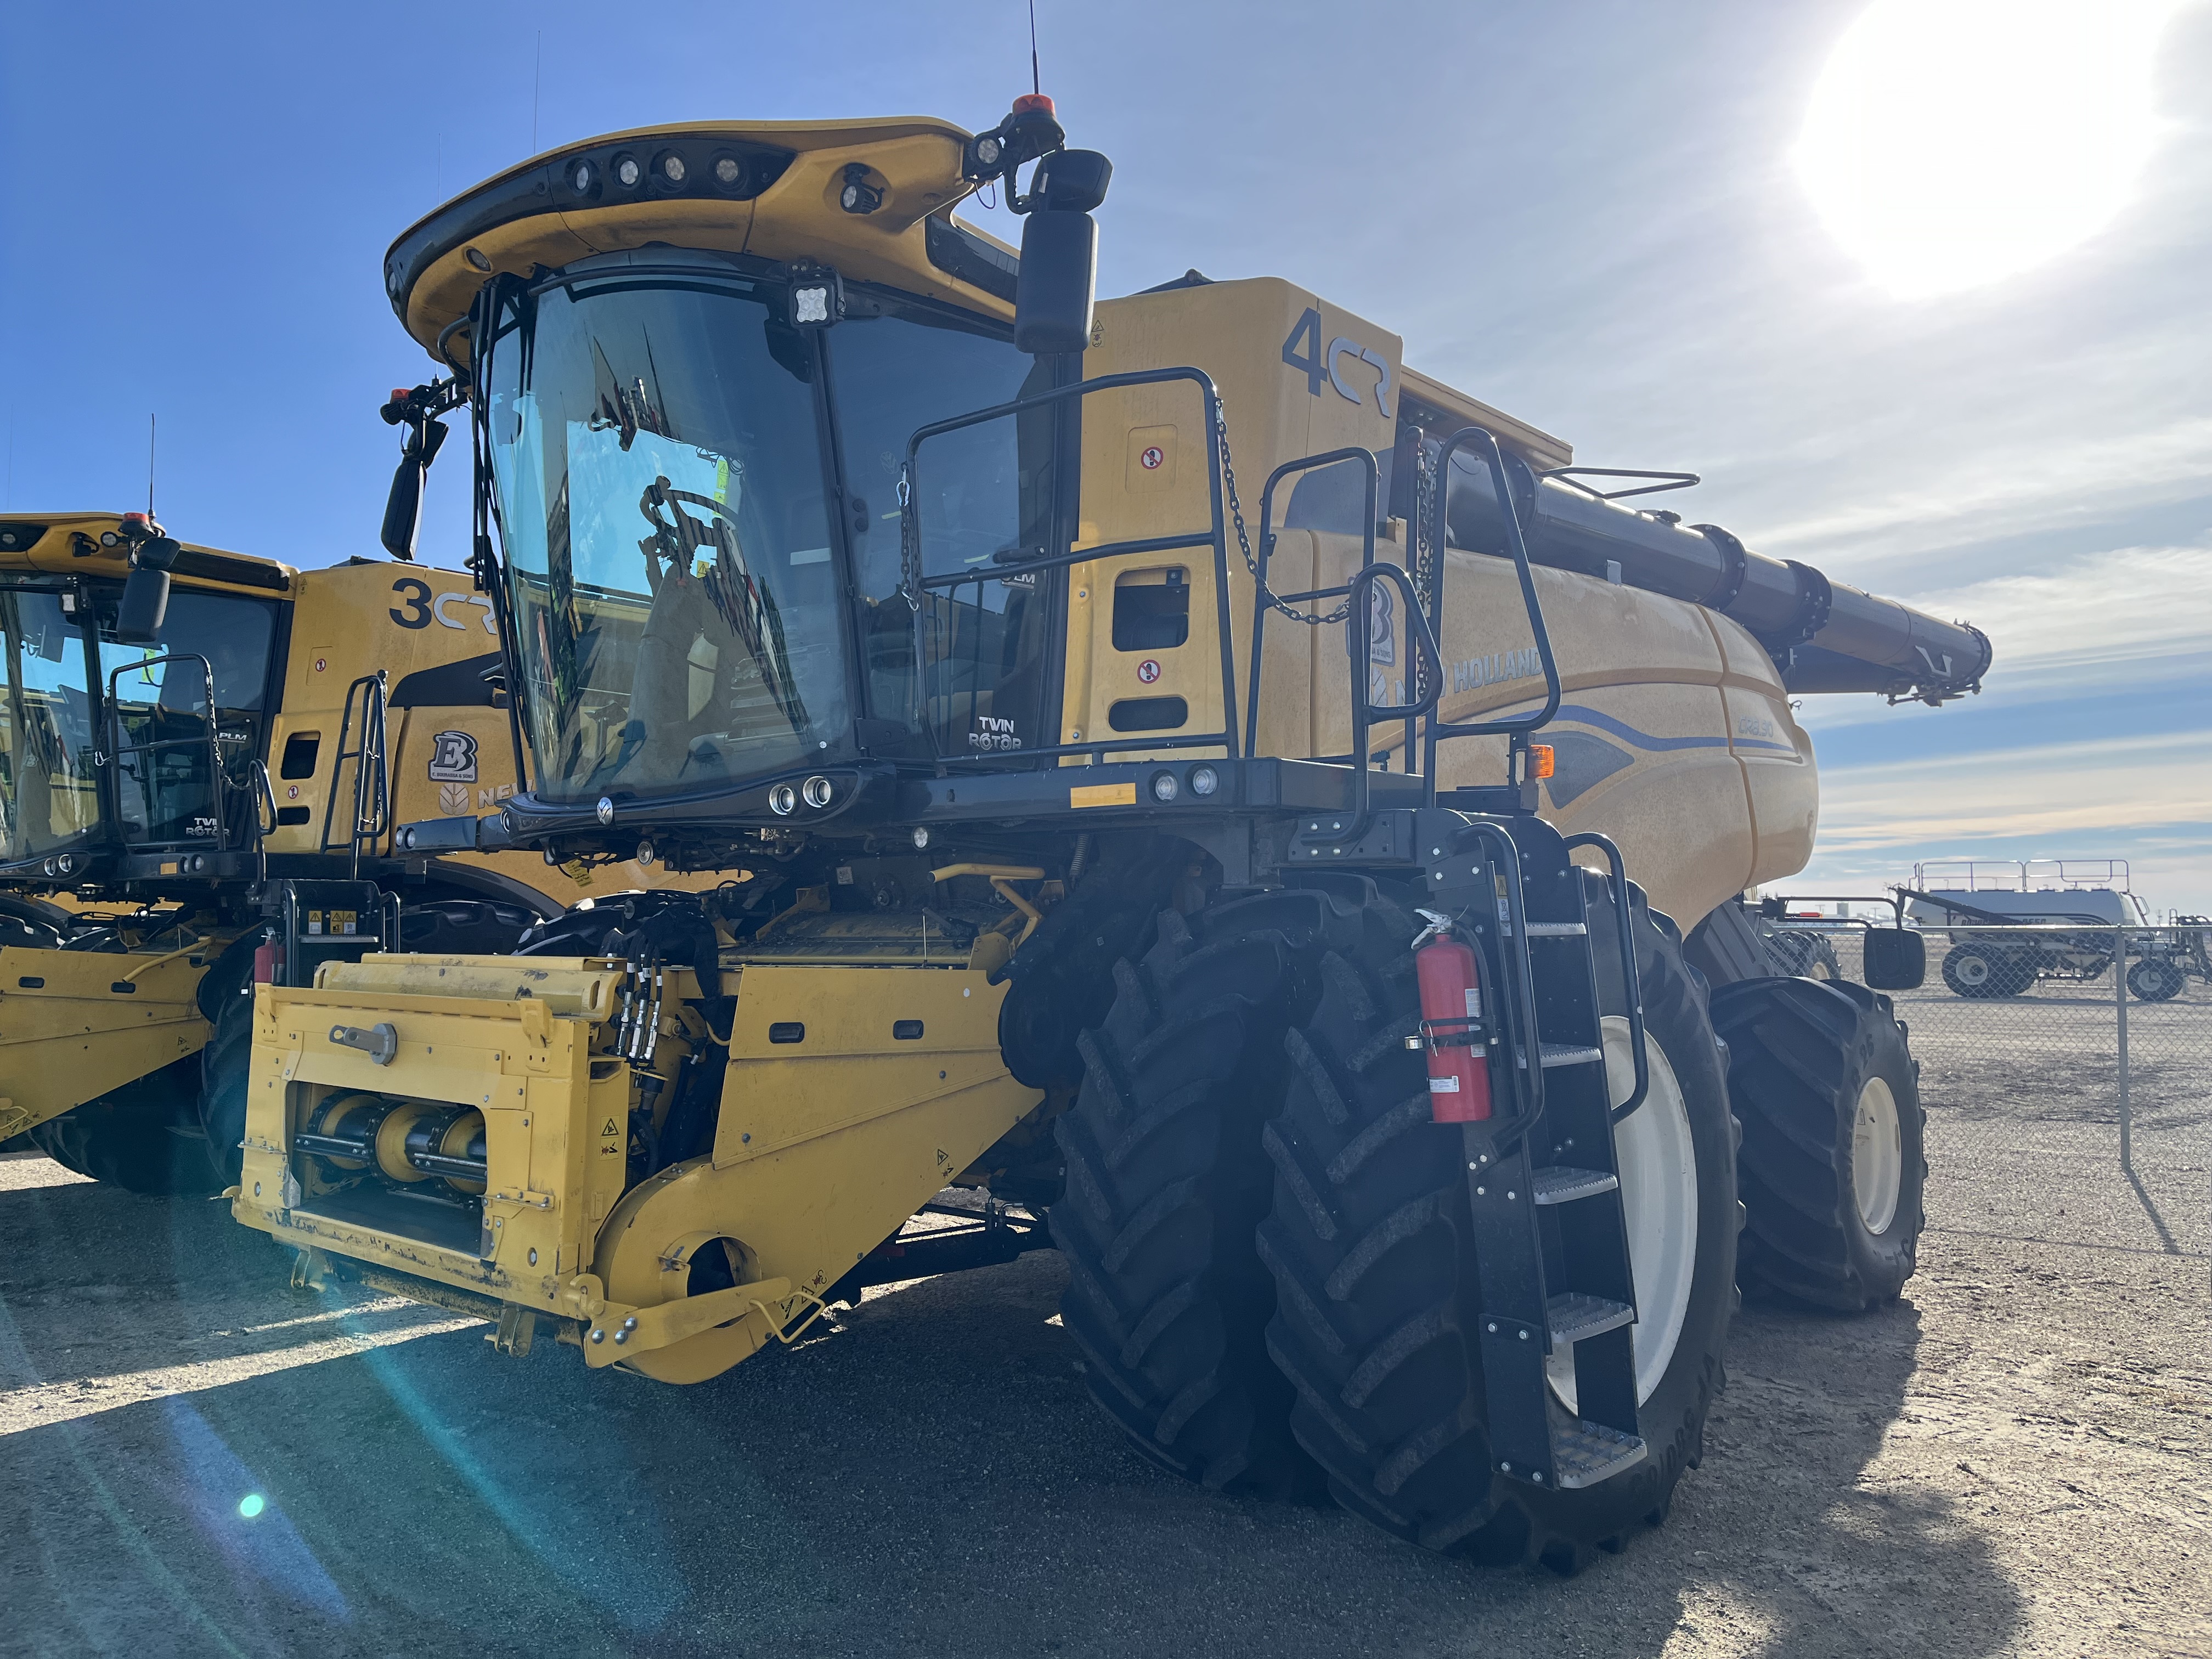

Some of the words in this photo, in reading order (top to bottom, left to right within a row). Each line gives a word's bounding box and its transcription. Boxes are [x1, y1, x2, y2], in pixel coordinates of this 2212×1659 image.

[1454, 647, 1544, 693] HOLLAND
[979, 716, 1014, 733] TWIN
[219, 732, 247, 741] PLM
[969, 732, 1022, 751] ROTOR
